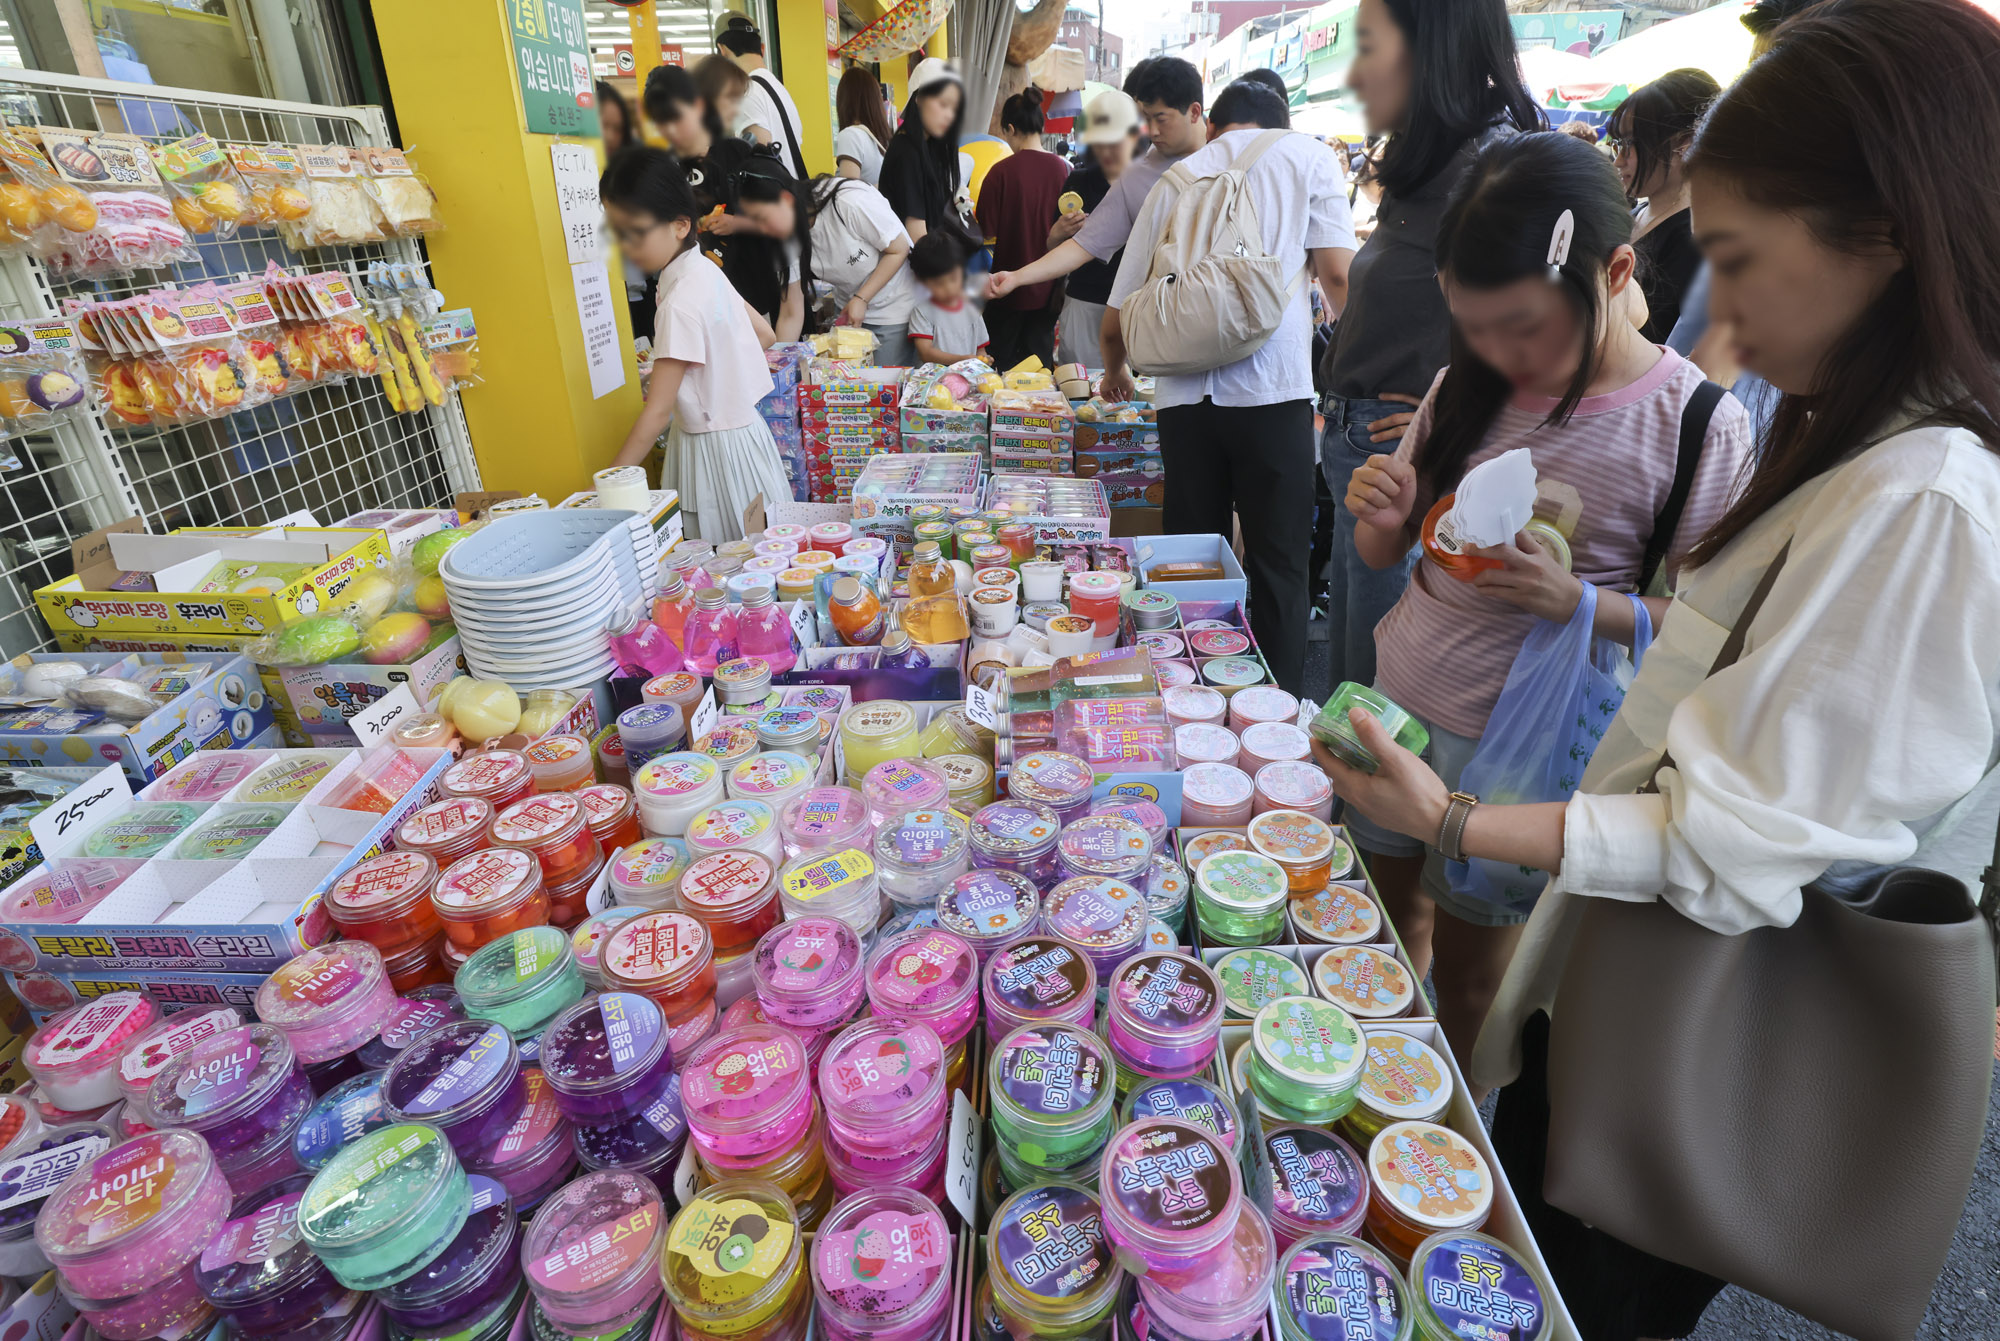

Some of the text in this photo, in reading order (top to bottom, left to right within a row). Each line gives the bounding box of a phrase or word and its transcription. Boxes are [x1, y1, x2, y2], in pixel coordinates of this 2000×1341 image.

[547, 1, 562, 43] 더
[561, 6, 584, 50] 많이
[521, 47, 575, 96] 있습니다.
[110, 167, 142, 182] 말랑이
[996, 415, 1049, 427] 브런치 찐득이
[995, 437, 1048, 449] 브런치 찐득이
[996, 459, 1048, 469] 브런치 찐득이
[315, 556, 355, 587] 먹지마 모양
[86, 600, 228, 620] 먹지마 모양 후라이
[1107, 732, 1122, 758] 소다
[1039, 762, 1070, 783] 인어의
[1056, 771, 1077, 787] 눈물
[1117, 787, 1143, 796] POP
[55, 787, 114, 836] 2500
[994, 813, 1016, 827] 눈물
[1000, 813, 1032, 835] 인어의
[901, 830, 944, 841] 인어의
[912, 840, 936, 850] 눈물
[1082, 835, 1101, 853] 눈물
[1101, 830, 1115, 856] 인어의
[700, 860, 744, 888] 슬라임
[968, 881, 991, 896] 눈물
[965, 892, 1012, 913] 인어의
[1072, 907, 1100, 925] 눈물
[1078, 893, 1118, 924] 인어의
[657, 924, 679, 963] 슬라임
[794, 936, 826, 949] 쏘오
[798, 925, 830, 937] 스윗
[34, 936, 276, 958] 투칼라 크런치 슬라임
[917, 947, 948, 966] 쏘오
[926, 938, 957, 956] 스윗
[123, 960, 150, 968] Color
[153, 960, 192, 968] Crunch
[194, 960, 223, 968] Slime
[289, 957, 328, 987] 스타
[294, 960, 349, 999] 샤이니
[1000, 947, 1073, 993] 스플렌더
[1344, 959, 1362, 991] 사각사각
[148, 982, 224, 1004] 크런치
[1035, 972, 1070, 1000] 스톤
[1136, 959, 1183, 1018] 스플렌더
[1172, 983, 1204, 1013] 스톤
[387, 1002, 436, 1043] 샤이니
[1288, 1018, 1310, 1057] 사각사각
[184, 1046, 252, 1084] 샤이니
[747, 1050, 769, 1078] 쏘오
[765, 1042, 788, 1069] 스윗
[854, 1056, 880, 1086] 쏘오
[1015, 1050, 1044, 1083] 스톤
[189, 1064, 244, 1096] 스타
[836, 1066, 863, 1094] 스윗
[1043, 1034, 1080, 1109] 스플렌더
[82, 1156, 165, 1206] 샤이니
[1121, 1143, 1217, 1192] 스플렌더
[1272, 1136, 1328, 1214] 스플렌더
[1308, 1152, 1344, 1185] 스톤
[1398, 1152, 1441, 1200] 사각사각
[91, 1178, 158, 1221] 스타
[1162, 1178, 1206, 1214] 스톤
[247, 1203, 283, 1258] 샤이니
[679, 1208, 712, 1247] 스윗
[701, 1214, 731, 1252] 쏘오
[1020, 1203, 1062, 1243] 스톤
[544, 1211, 653, 1278] 트윙클스타
[889, 1230, 914, 1264] 쏘오
[909, 1223, 933, 1260] 스윗
[1015, 1215, 1104, 1285] 스플렌더
[1459, 1254, 1502, 1287] 스톤
[1306, 1273, 1337, 1315] 스톤
[1432, 1278, 1536, 1328] 스플렌더
